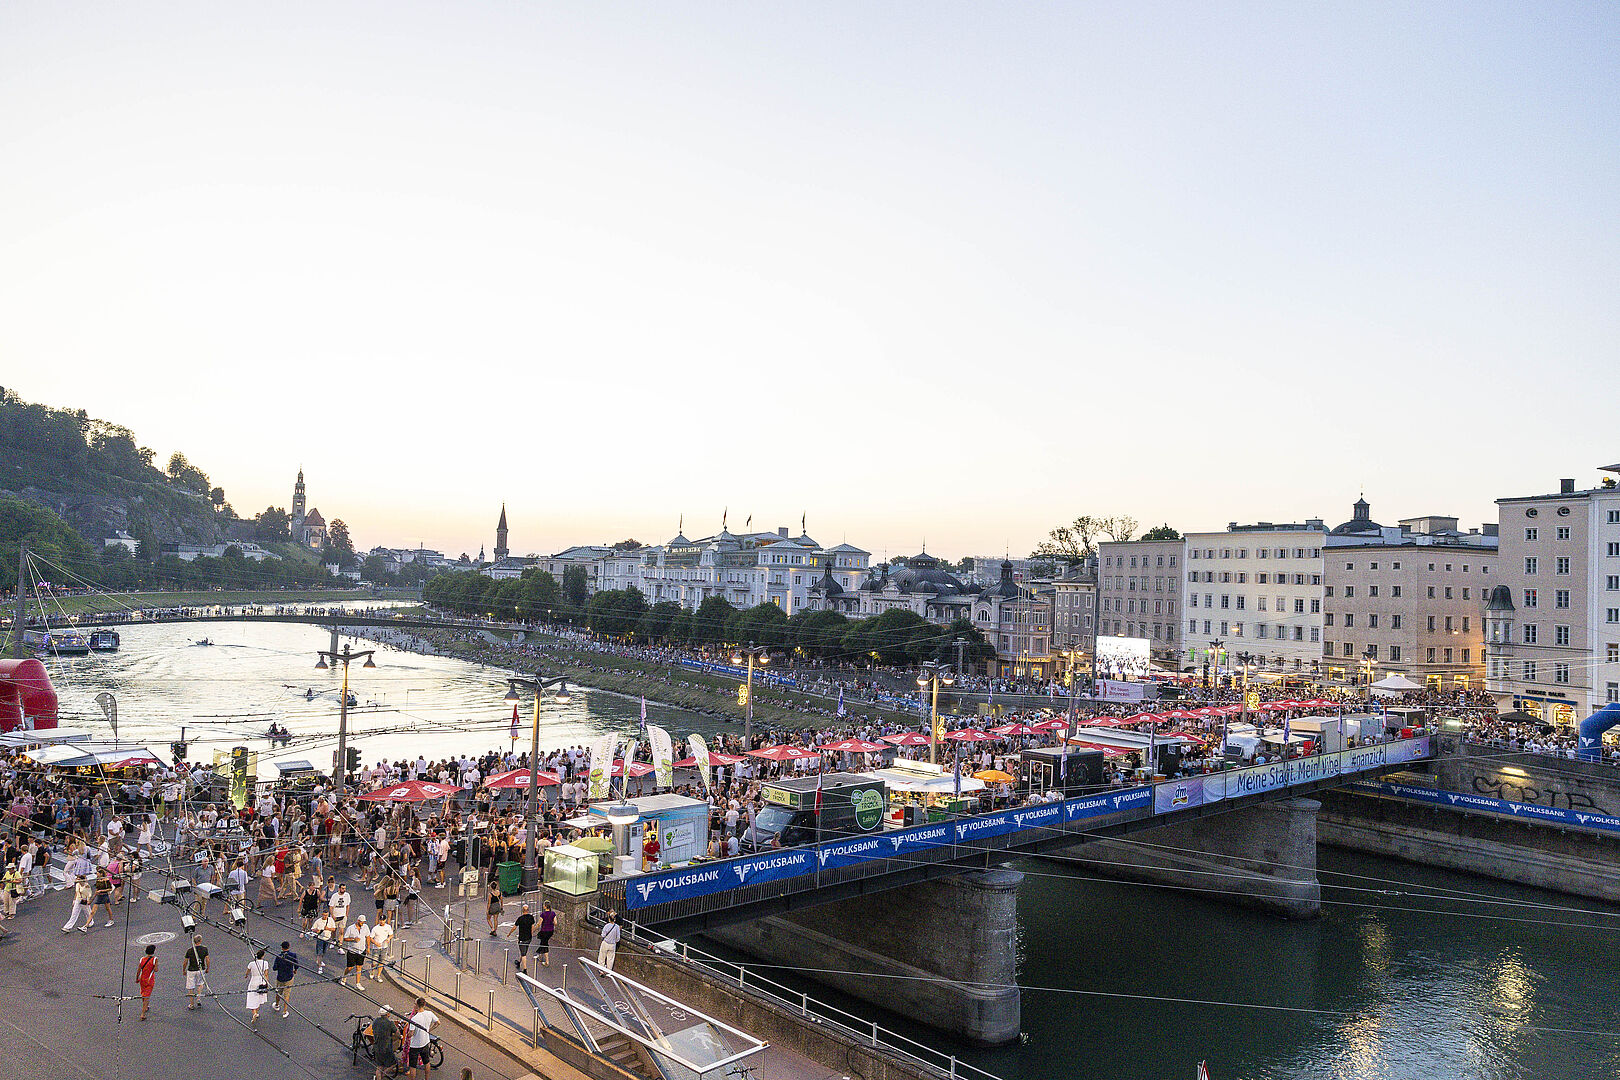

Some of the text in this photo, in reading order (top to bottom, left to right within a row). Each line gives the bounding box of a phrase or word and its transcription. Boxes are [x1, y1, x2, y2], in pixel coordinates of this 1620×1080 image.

[1237, 770, 1267, 793] Meine
[1298, 759, 1319, 780] Mein
[1120, 790, 1151, 802] VOLKSBANK
[1402, 786, 1439, 798] VOLKSBANK
[1075, 798, 1108, 811] VOLKSBANK
[1460, 796, 1500, 808] VOLKSBANK
[1024, 807, 1059, 820] VOLKSBANK
[1522, 805, 1566, 818] VOLKSBANK
[967, 817, 1006, 832] VOLKSBANK
[1590, 815, 1620, 826] VOLKSB
[903, 827, 946, 843] VOLKSBANK
[832, 840, 879, 856] VOLKSBANK
[752, 853, 806, 872] VOLKSBANK
[658, 869, 719, 890] VOLKSBANK
